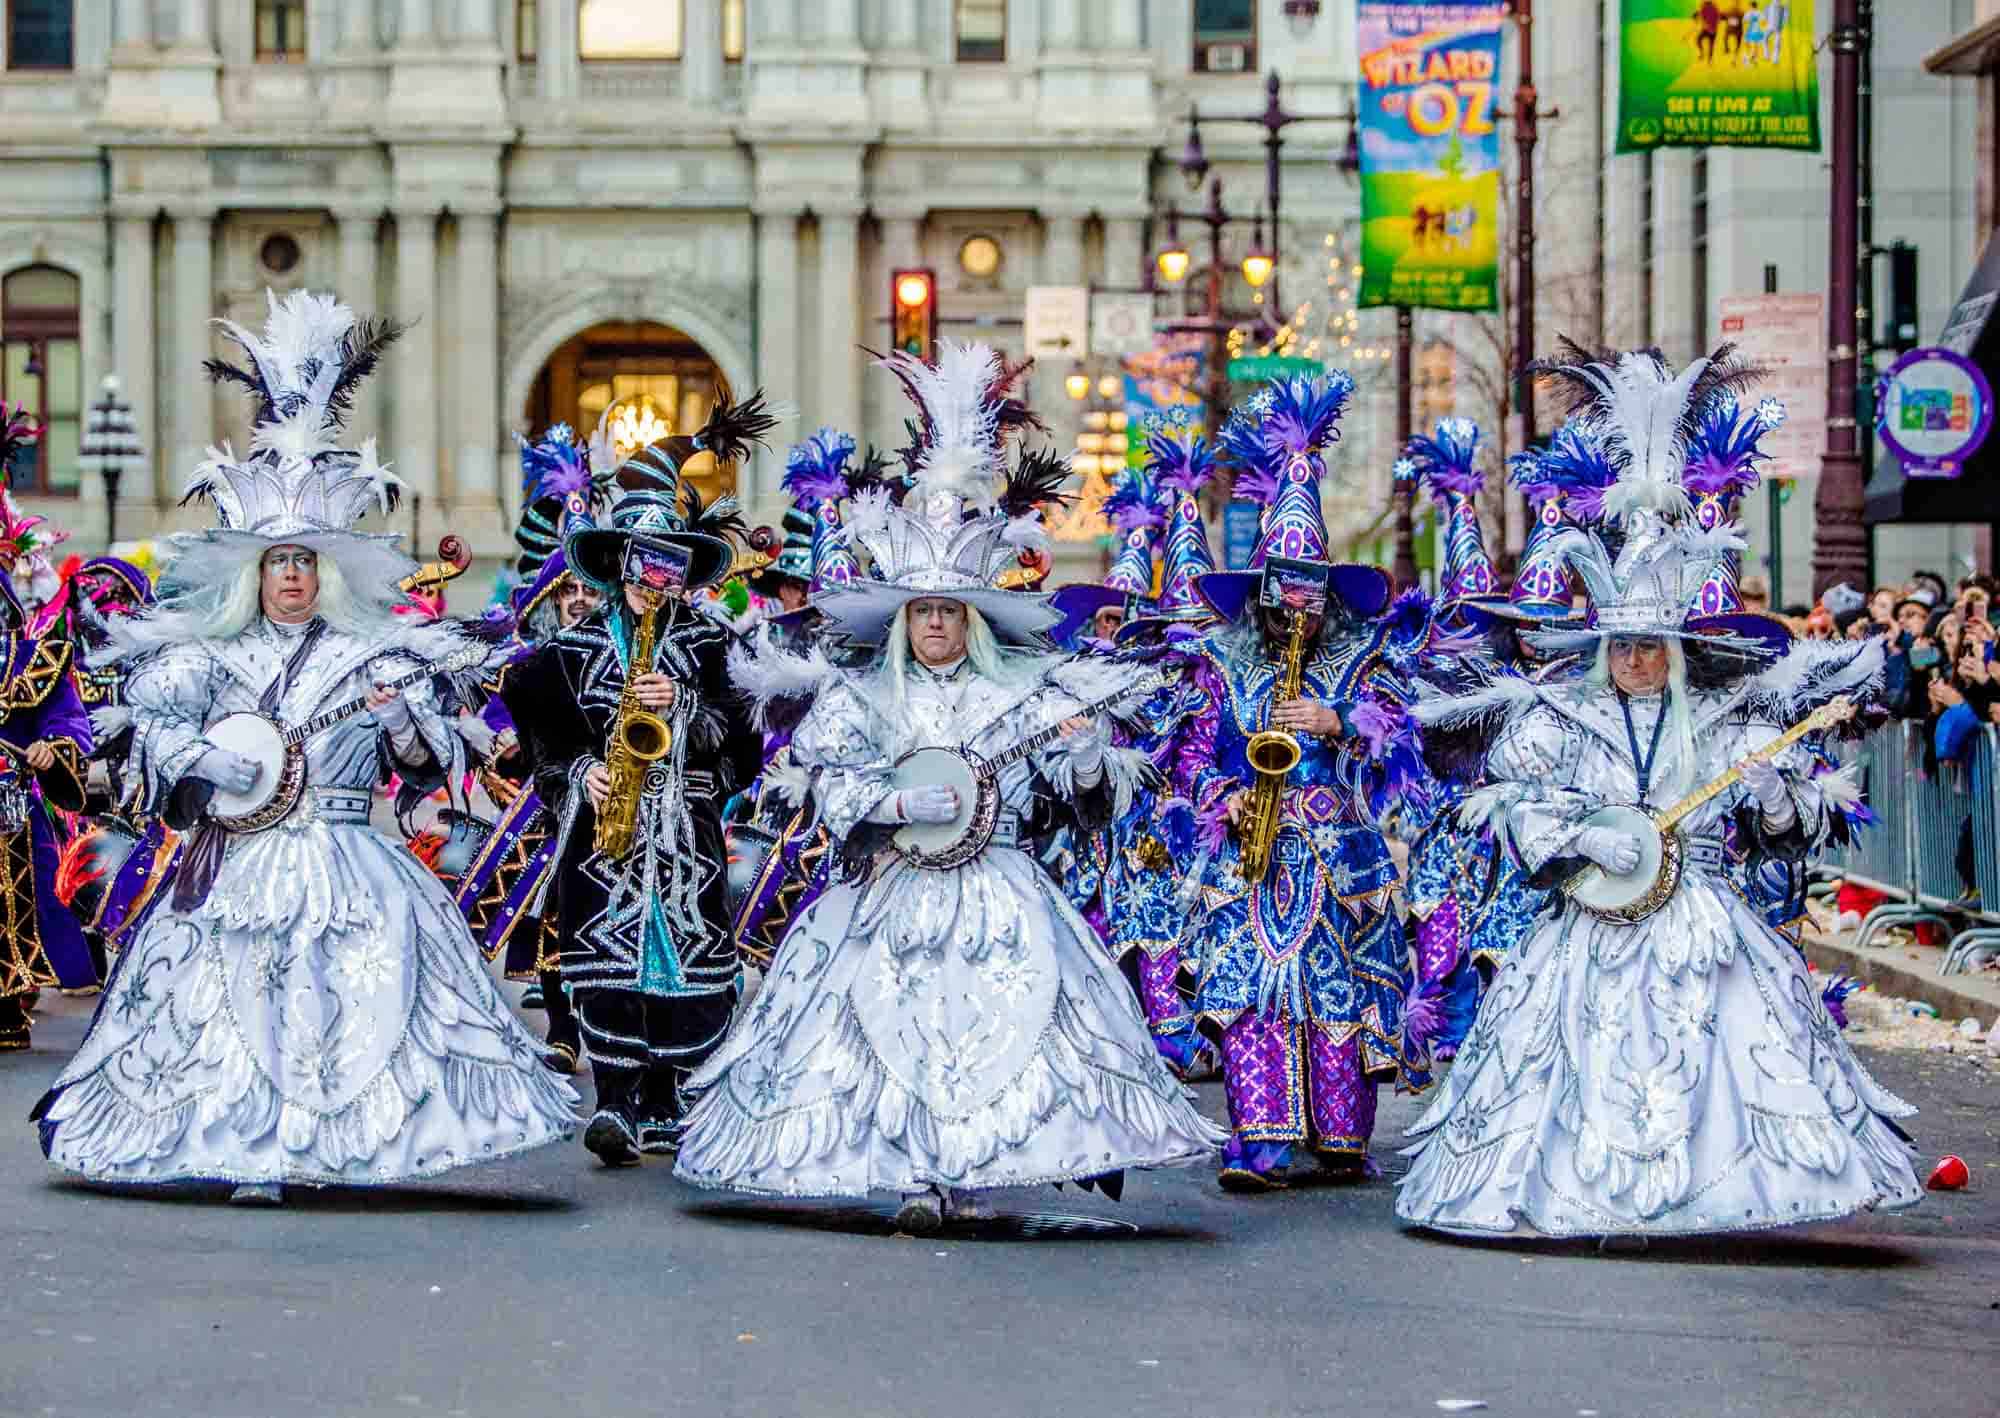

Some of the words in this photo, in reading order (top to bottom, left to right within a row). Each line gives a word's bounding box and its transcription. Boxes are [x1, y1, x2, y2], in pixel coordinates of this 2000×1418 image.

[1360, 49, 1494, 90] WIZARD
[1407, 81, 1495, 135] OZ
[1698, 95, 1712, 112] IT
[1715, 95, 1748, 112] LIVE
[1751, 95, 1773, 112] AT
